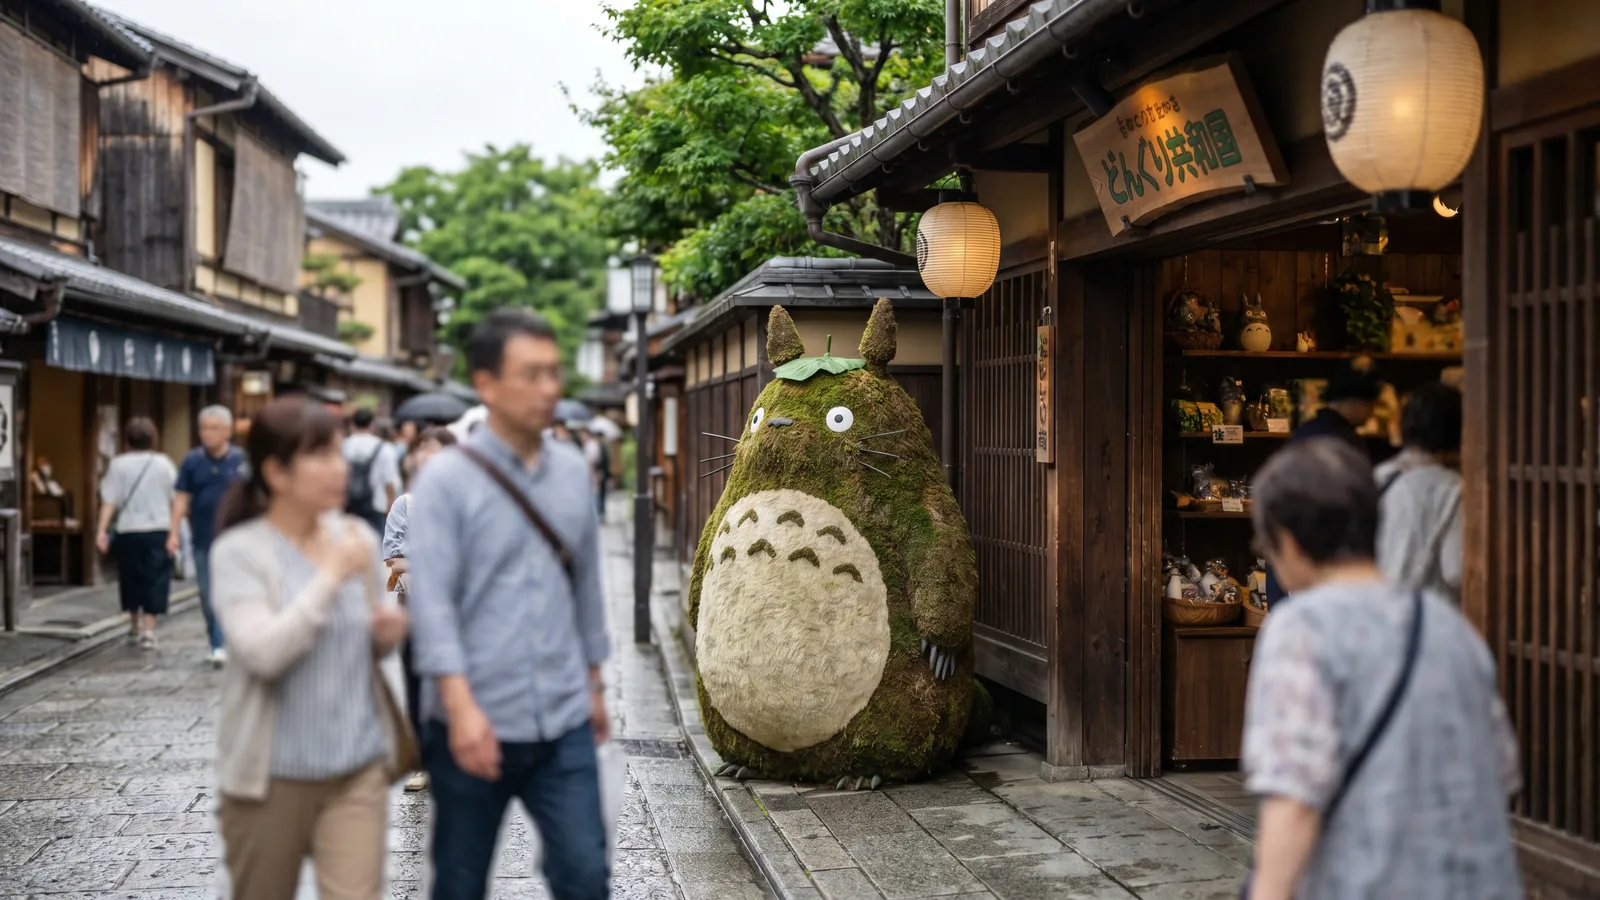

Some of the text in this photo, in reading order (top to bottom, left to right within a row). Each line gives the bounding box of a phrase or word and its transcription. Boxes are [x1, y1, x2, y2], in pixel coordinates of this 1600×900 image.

[1102, 108, 1242, 204] どんぐり共和国
